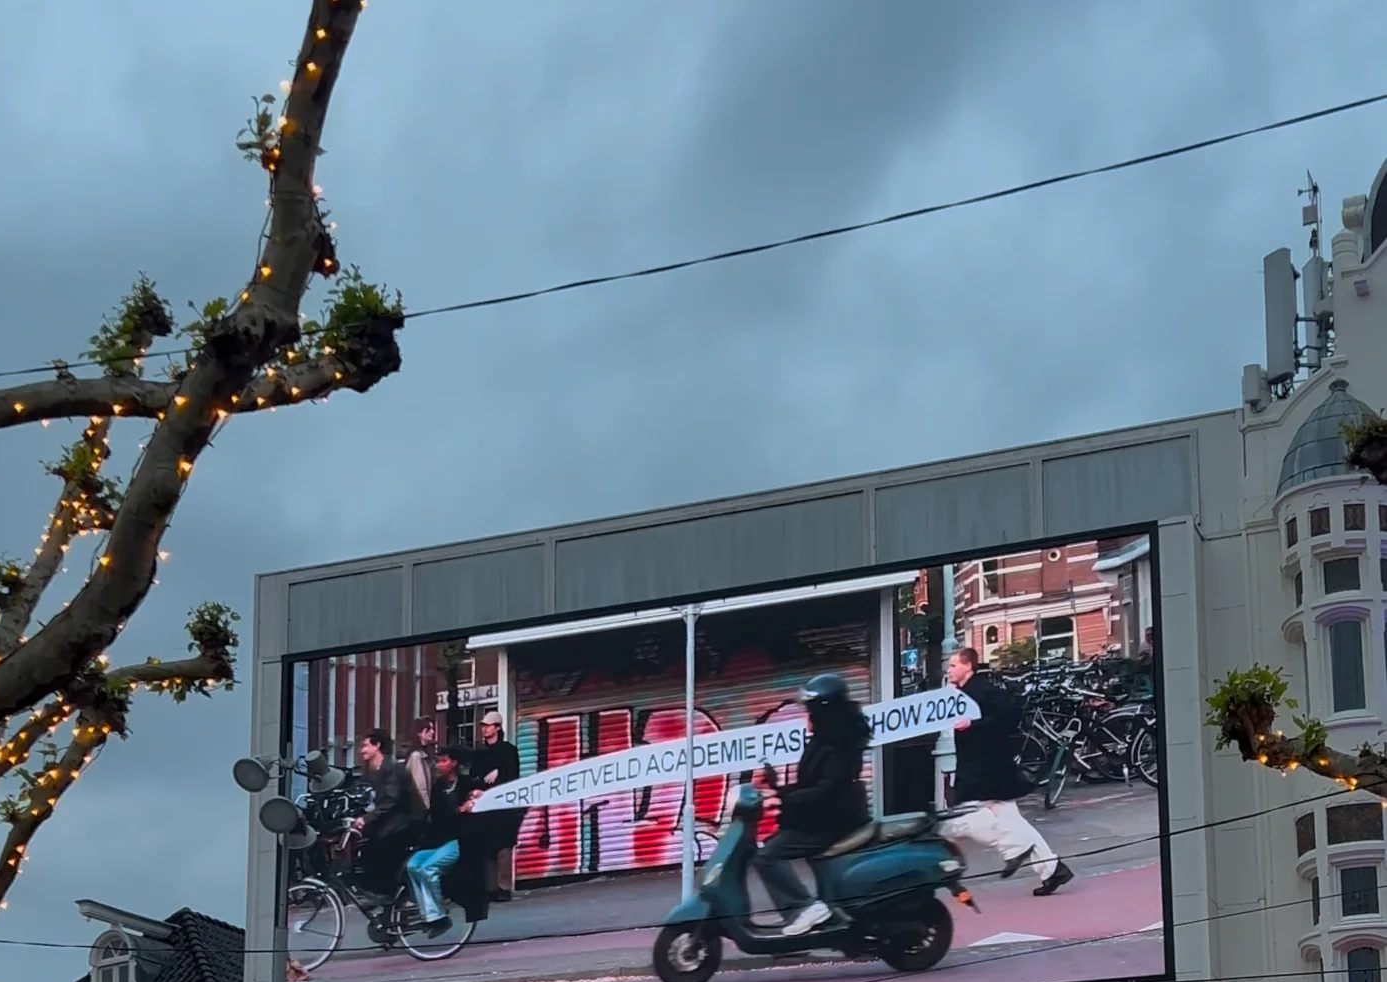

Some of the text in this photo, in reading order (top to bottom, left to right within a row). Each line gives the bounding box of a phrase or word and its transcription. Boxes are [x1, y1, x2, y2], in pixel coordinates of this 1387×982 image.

[549, 757, 641, 799] RIETVELD
[646, 735, 757, 774] ACADEMIE
[867, 702, 923, 735] HOW
[926, 693, 967, 725] 2026
